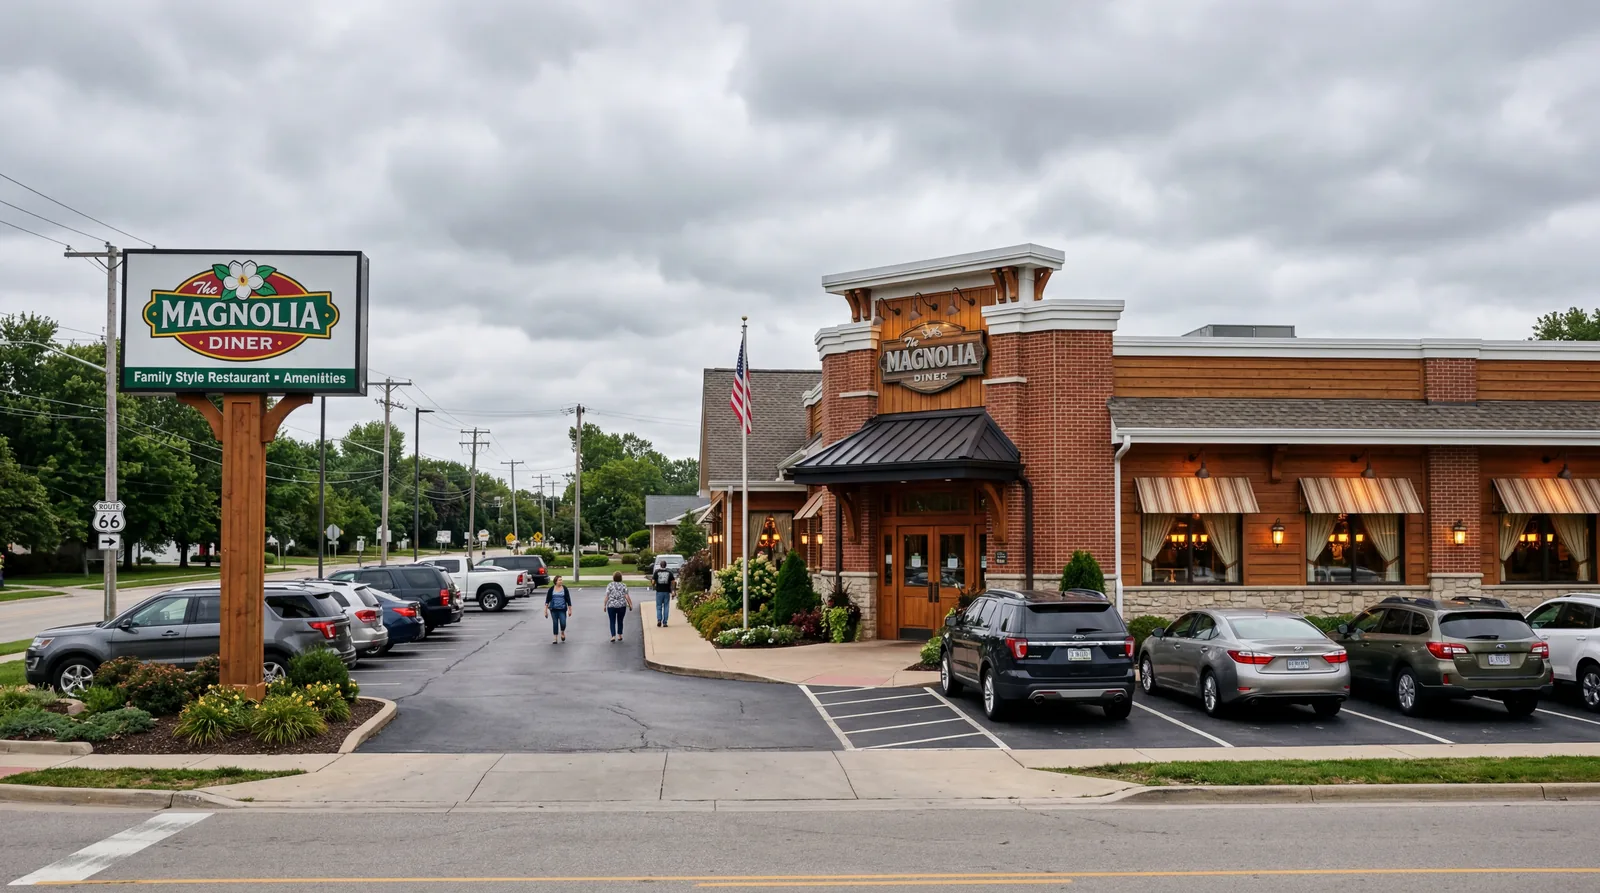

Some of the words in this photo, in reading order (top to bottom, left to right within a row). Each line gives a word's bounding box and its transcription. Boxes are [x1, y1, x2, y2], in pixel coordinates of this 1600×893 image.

[193, 281, 218, 295] The
[161, 300, 321, 330] MAGNOLIA
[209, 336, 272, 350] DINER
[904, 337, 920, 348] The
[886, 343, 977, 372] MAGNOLIA
[134, 371, 172, 385] Family
[175, 371, 204, 385] Style
[208, 371, 270, 384] Restaurant
[914, 372, 947, 382] DINER
[99, 515, 120, 528] 66
